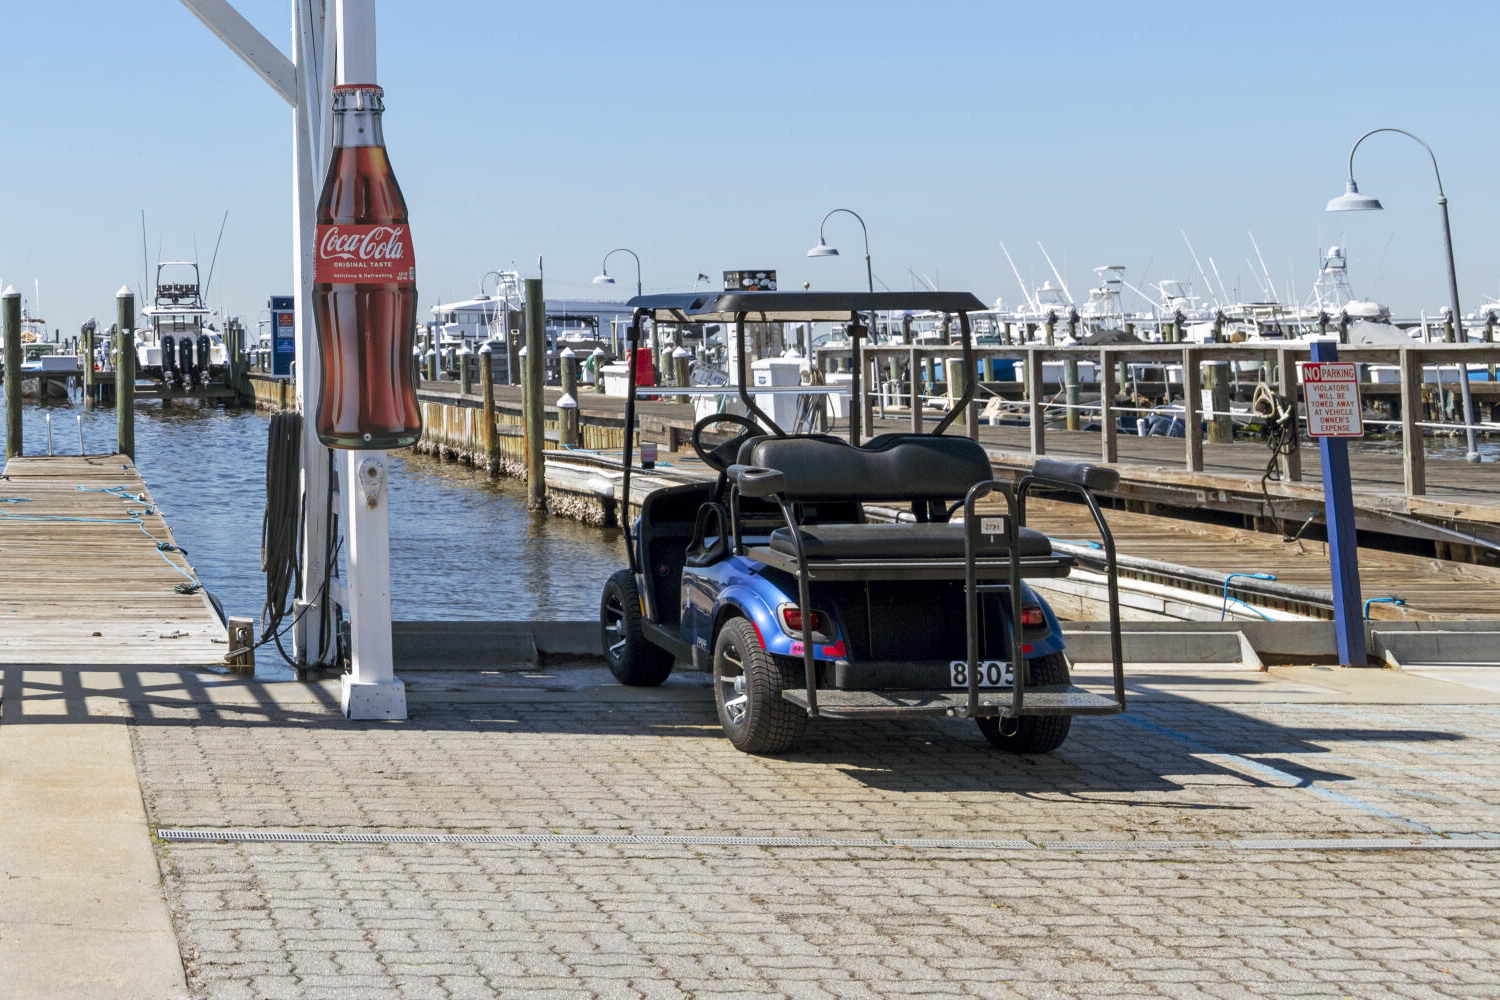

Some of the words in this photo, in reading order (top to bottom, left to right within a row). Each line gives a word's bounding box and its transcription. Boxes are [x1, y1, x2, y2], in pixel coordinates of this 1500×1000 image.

[320, 226, 404, 260] Coca-Cola
[1304, 366, 1320, 380] NO
[1321, 368, 1354, 378] PARKING
